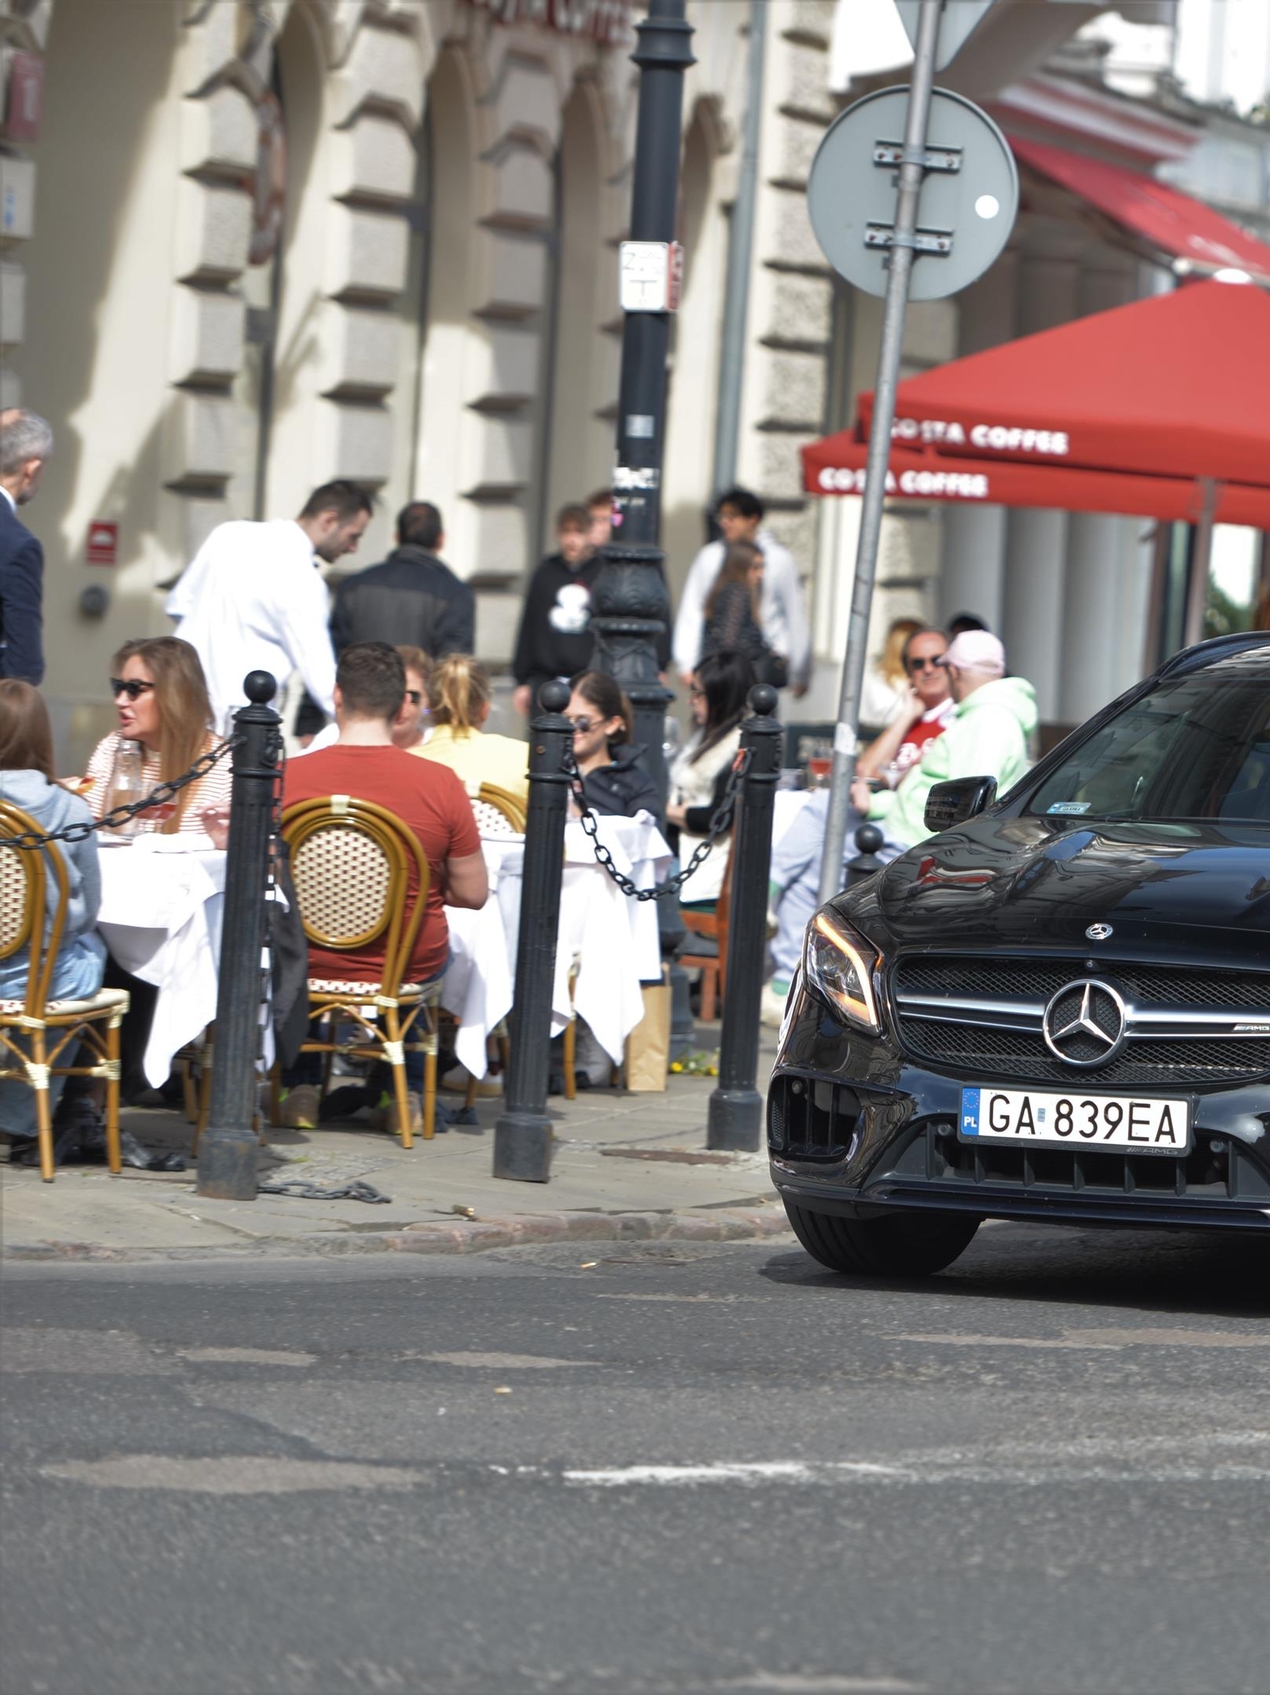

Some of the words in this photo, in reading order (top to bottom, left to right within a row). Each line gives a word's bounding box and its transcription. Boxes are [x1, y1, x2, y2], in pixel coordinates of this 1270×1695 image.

[970, 424, 1069, 455] COFFEE
[900, 470, 989, 497] COFFEE
[964, 1116, 978, 1128] PL
[989, 1094, 1036, 1135] GA
[1054, 1099, 1176, 1143] 839EA
